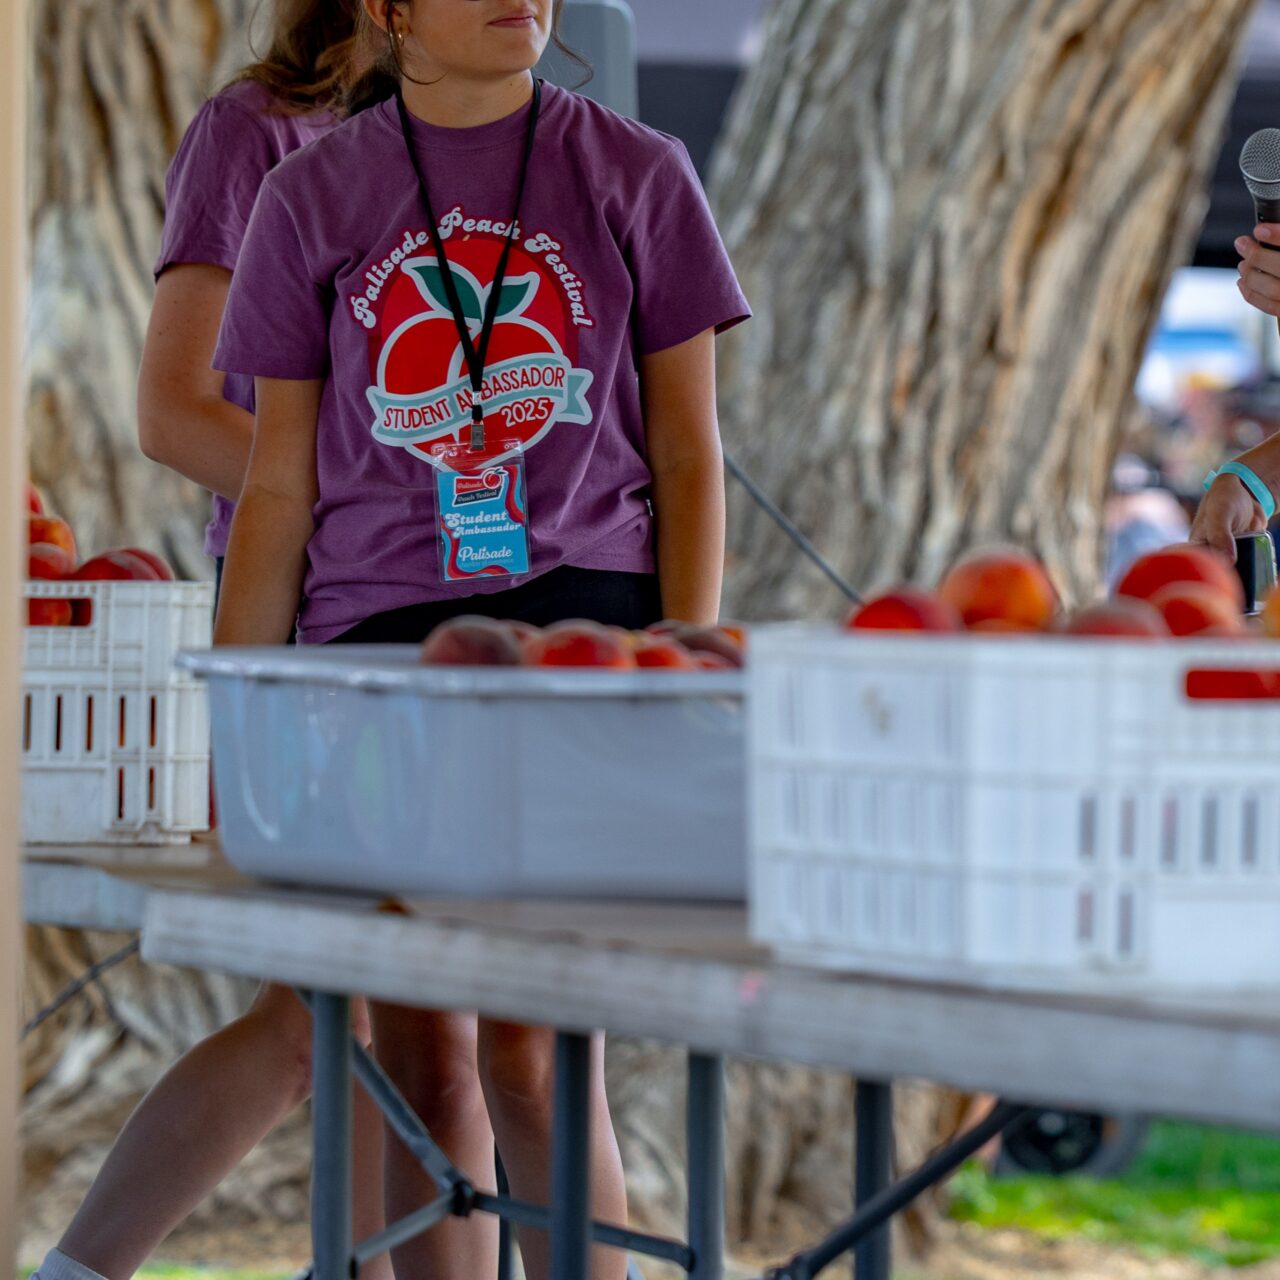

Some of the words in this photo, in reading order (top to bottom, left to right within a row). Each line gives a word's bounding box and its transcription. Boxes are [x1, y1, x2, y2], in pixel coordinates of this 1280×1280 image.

[350, 230, 429, 329] Palisade
[437, 206, 520, 240] Peach
[524, 232, 593, 327] Festival
[383, 398, 451, 430] STUDENT
[500, 398, 551, 428] 2025
[445, 511, 507, 528] Student
[452, 522, 522, 539] Ambassador
[458, 546, 513, 562] Palisade
